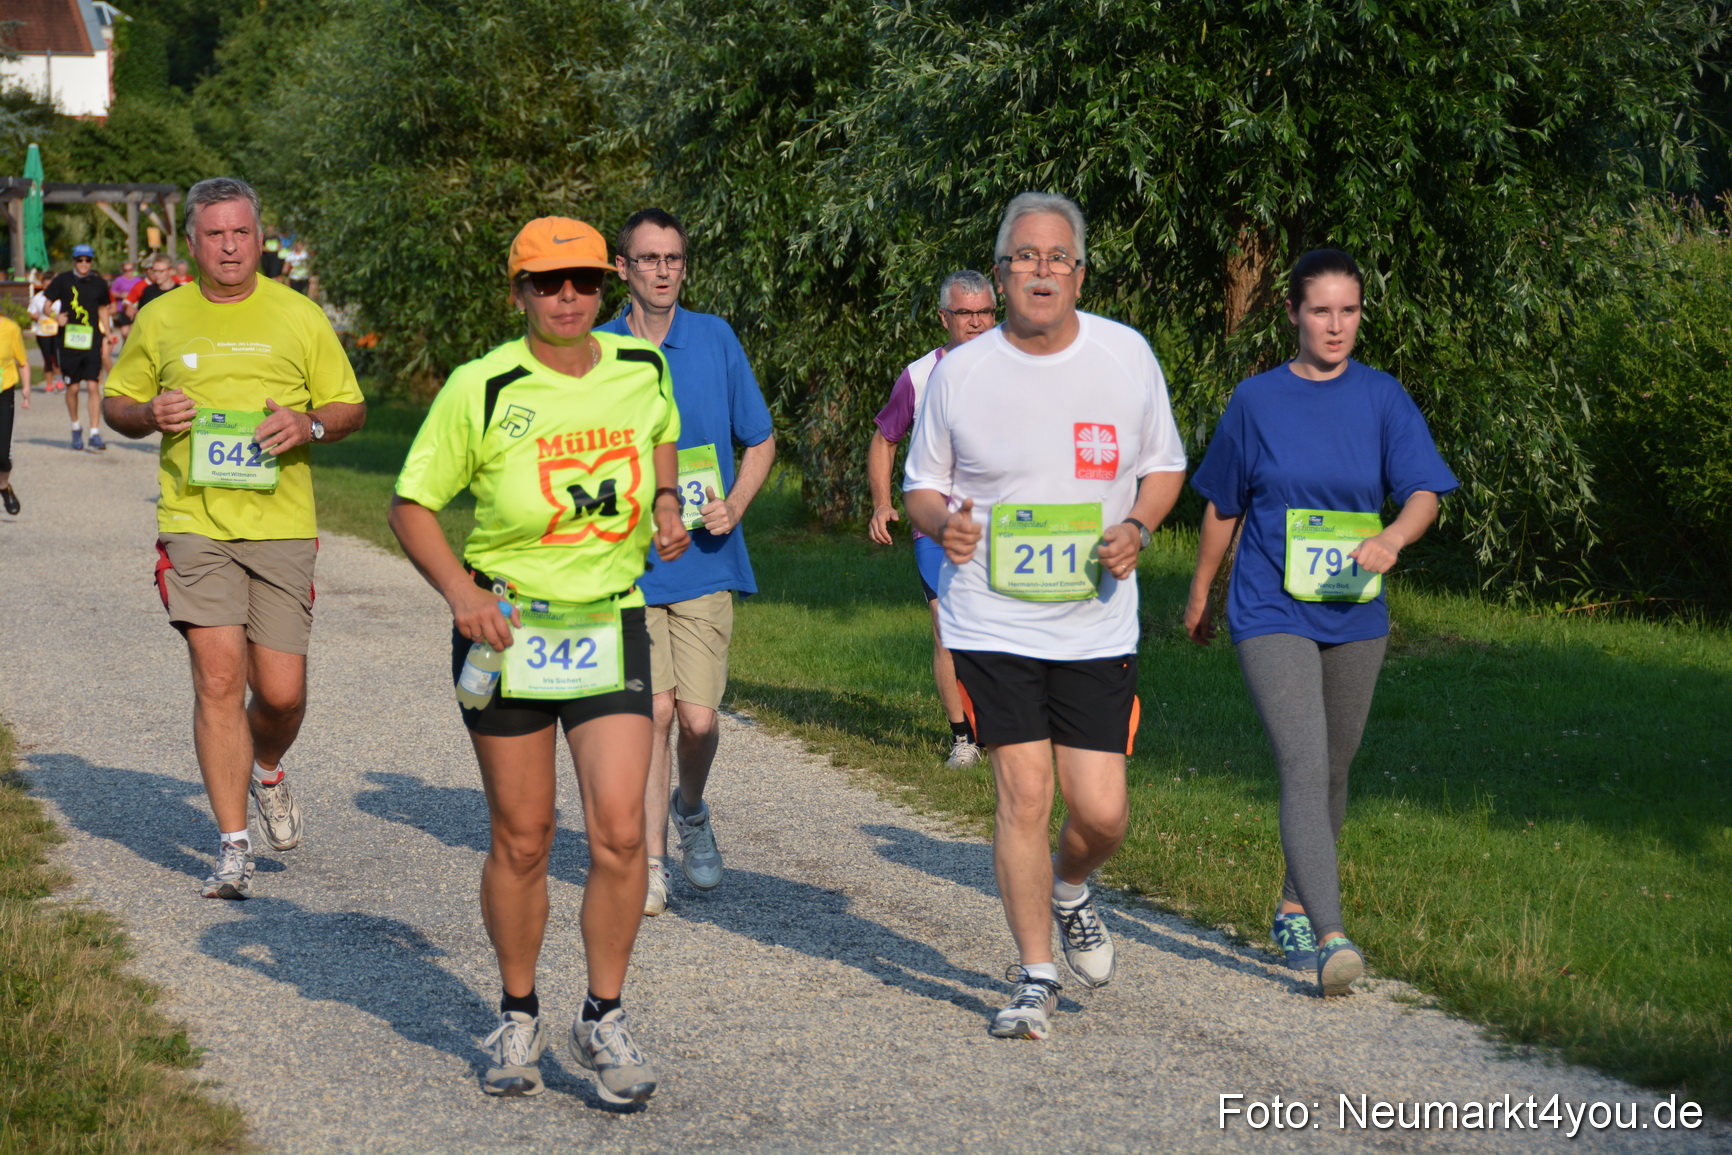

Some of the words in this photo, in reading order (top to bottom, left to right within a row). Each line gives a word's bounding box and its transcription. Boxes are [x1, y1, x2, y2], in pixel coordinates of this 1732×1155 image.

[208, 440, 262, 468] 642
[535, 427, 635, 459] Müller
[566, 478, 620, 517] M
[1014, 543, 1076, 574] 211
[1306, 547, 1358, 577] 791
[526, 635, 598, 670] 342
